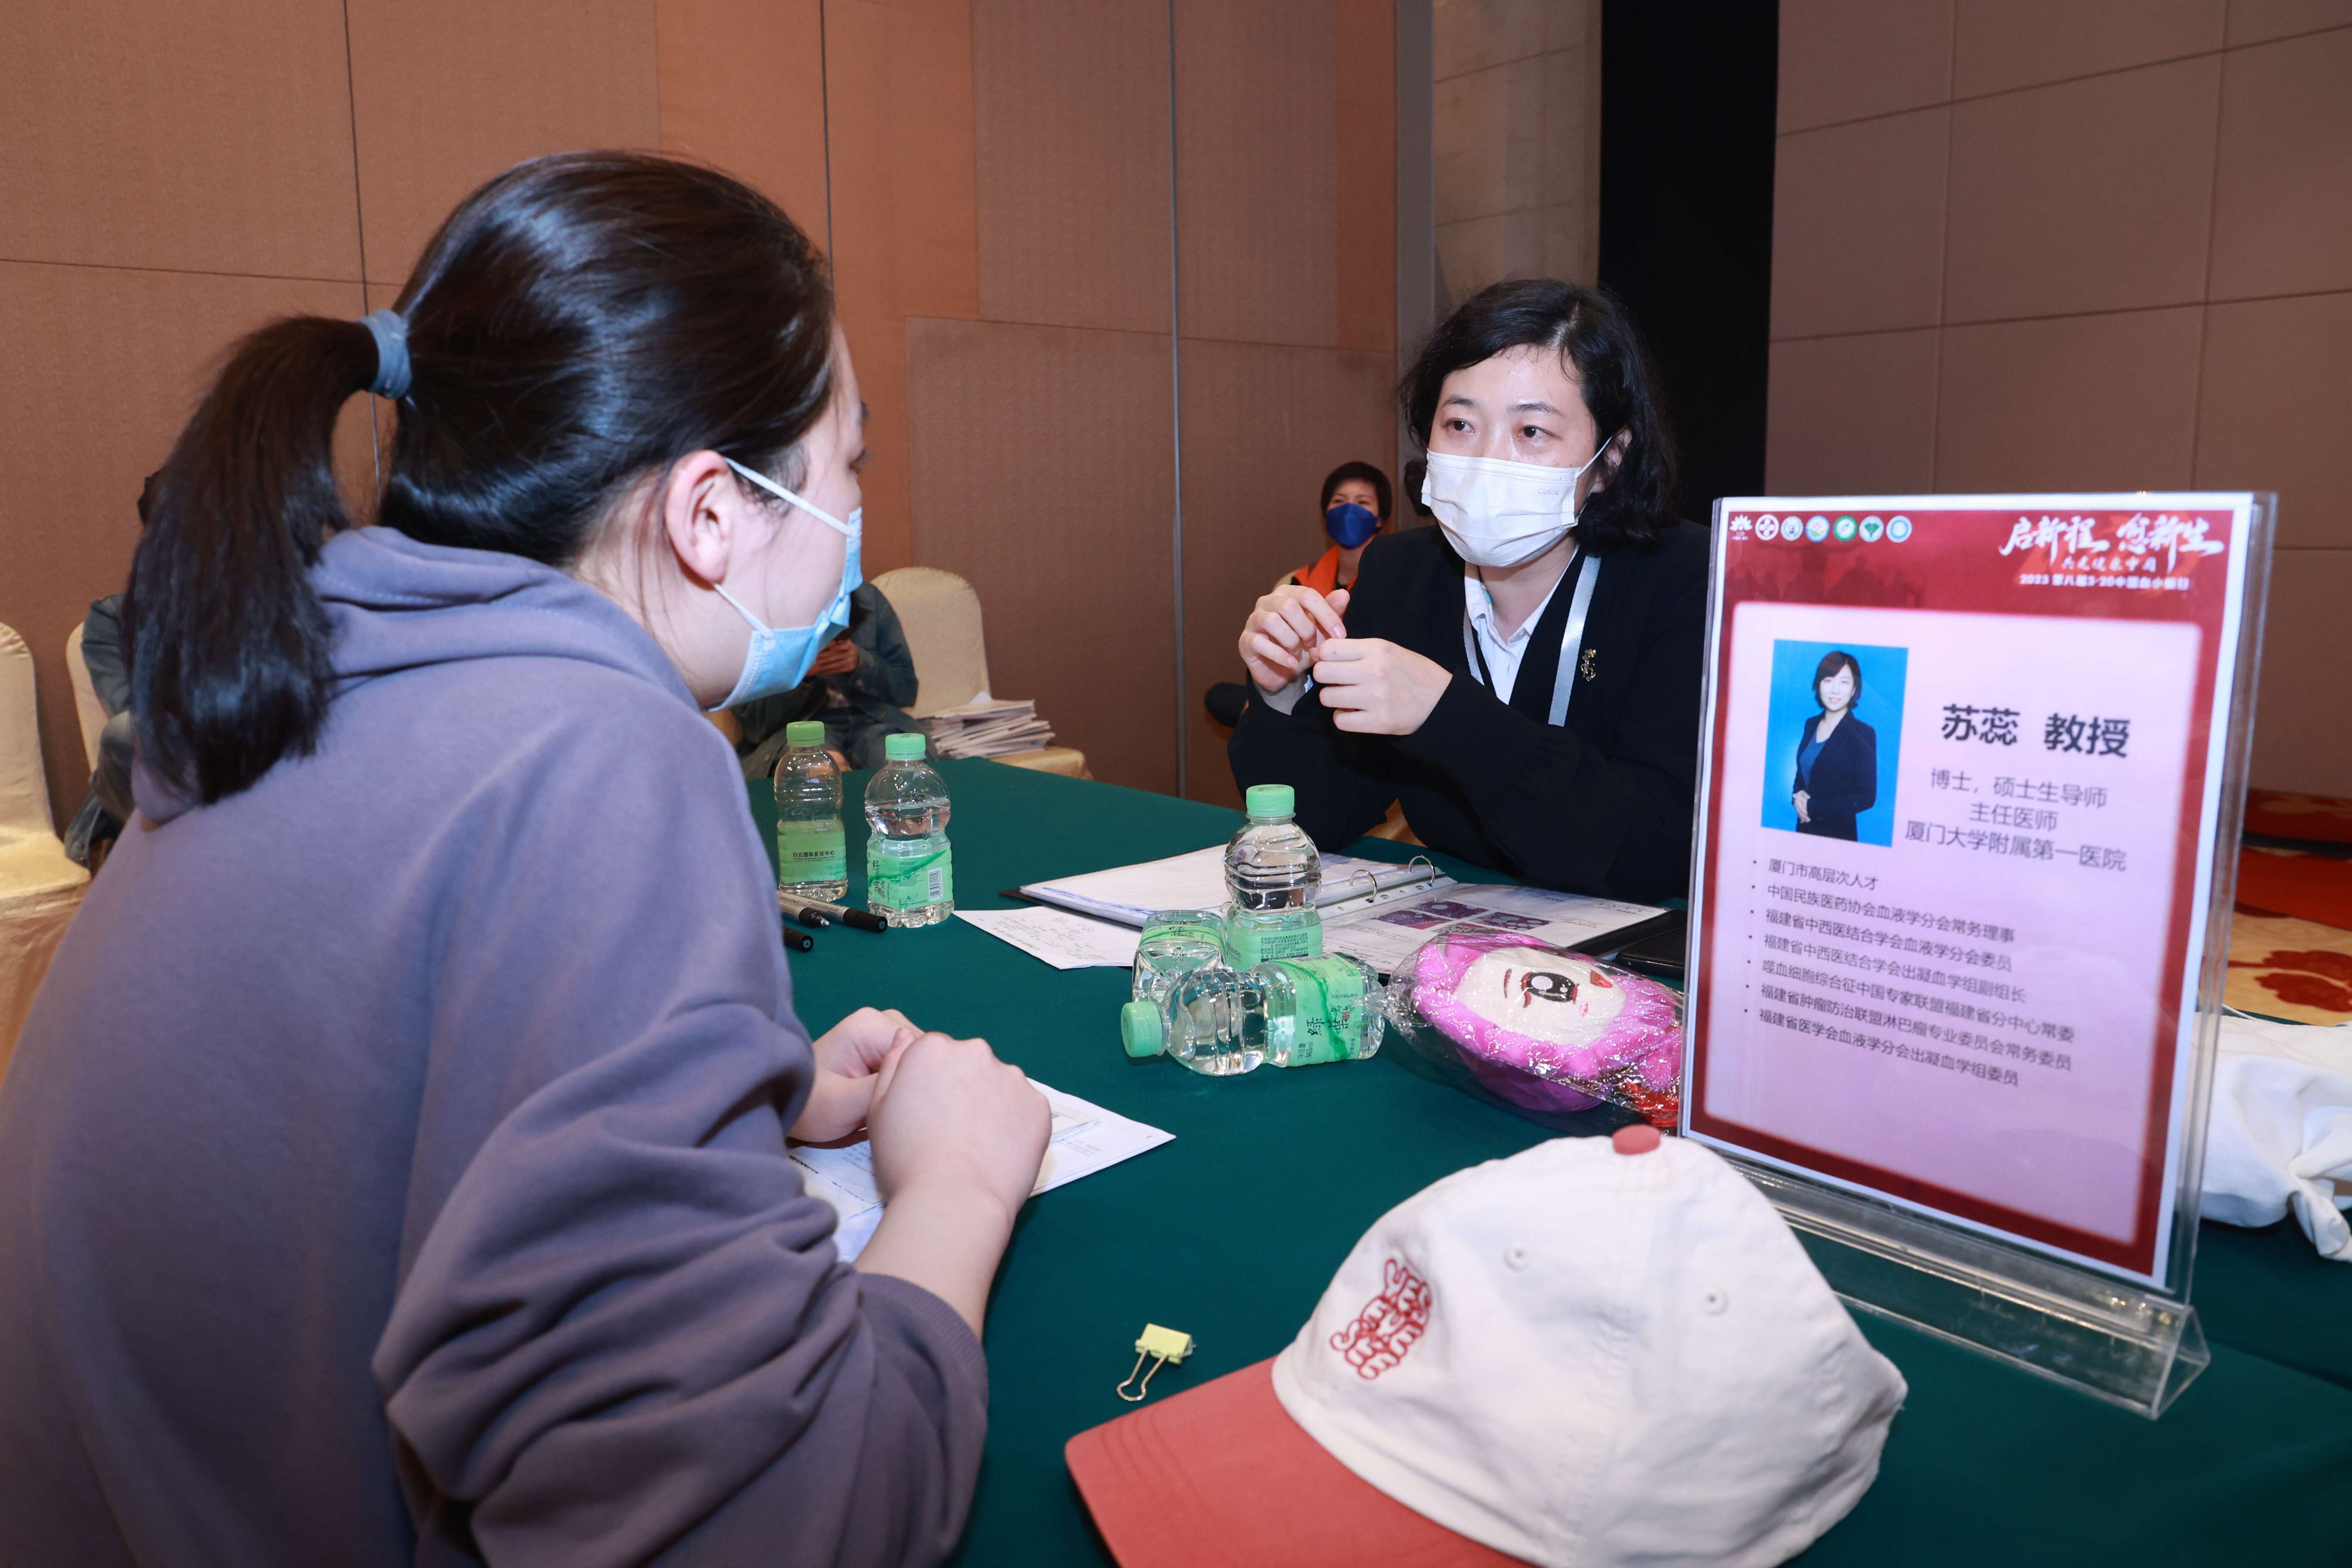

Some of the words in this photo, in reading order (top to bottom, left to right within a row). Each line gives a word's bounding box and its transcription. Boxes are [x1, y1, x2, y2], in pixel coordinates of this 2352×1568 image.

[1999, 516, 2110, 566] 启新程
[2019, 574, 2049, 585] 2023
[1941, 704, 2020, 746] 苏蕊
[2044, 713, 2130, 758] 教授
[1969, 802, 2058, 832] 主任医师
[1905, 821, 2126, 872] 厦门大学附属第一医院
[1768, 859, 1879, 890] 厦门市高层次人才
[1767, 884, 2015, 942] 中国民族医药协会血液学分会常务理事
[1766, 908, 2012, 972] 福建省中西医结合学会血液学分会委员
[1764, 934, 2026, 1004] 福建省中西医结合学会出凝血学组副组长
[1761, 984, 2071, 1071] 福建省肿瘤防治联盟淋巴瘤专业委员会常务委员
[1763, 960, 2075, 1044] 噬血细胞综合征中国专家联盟福建省分中心常委
[1297, 1043, 1306, 1059] 净含量
[1305, 1042, 1314, 1058] 365ml
[1760, 1008, 2019, 1087] 福建省医学会血液学分会出凝血学组委员
